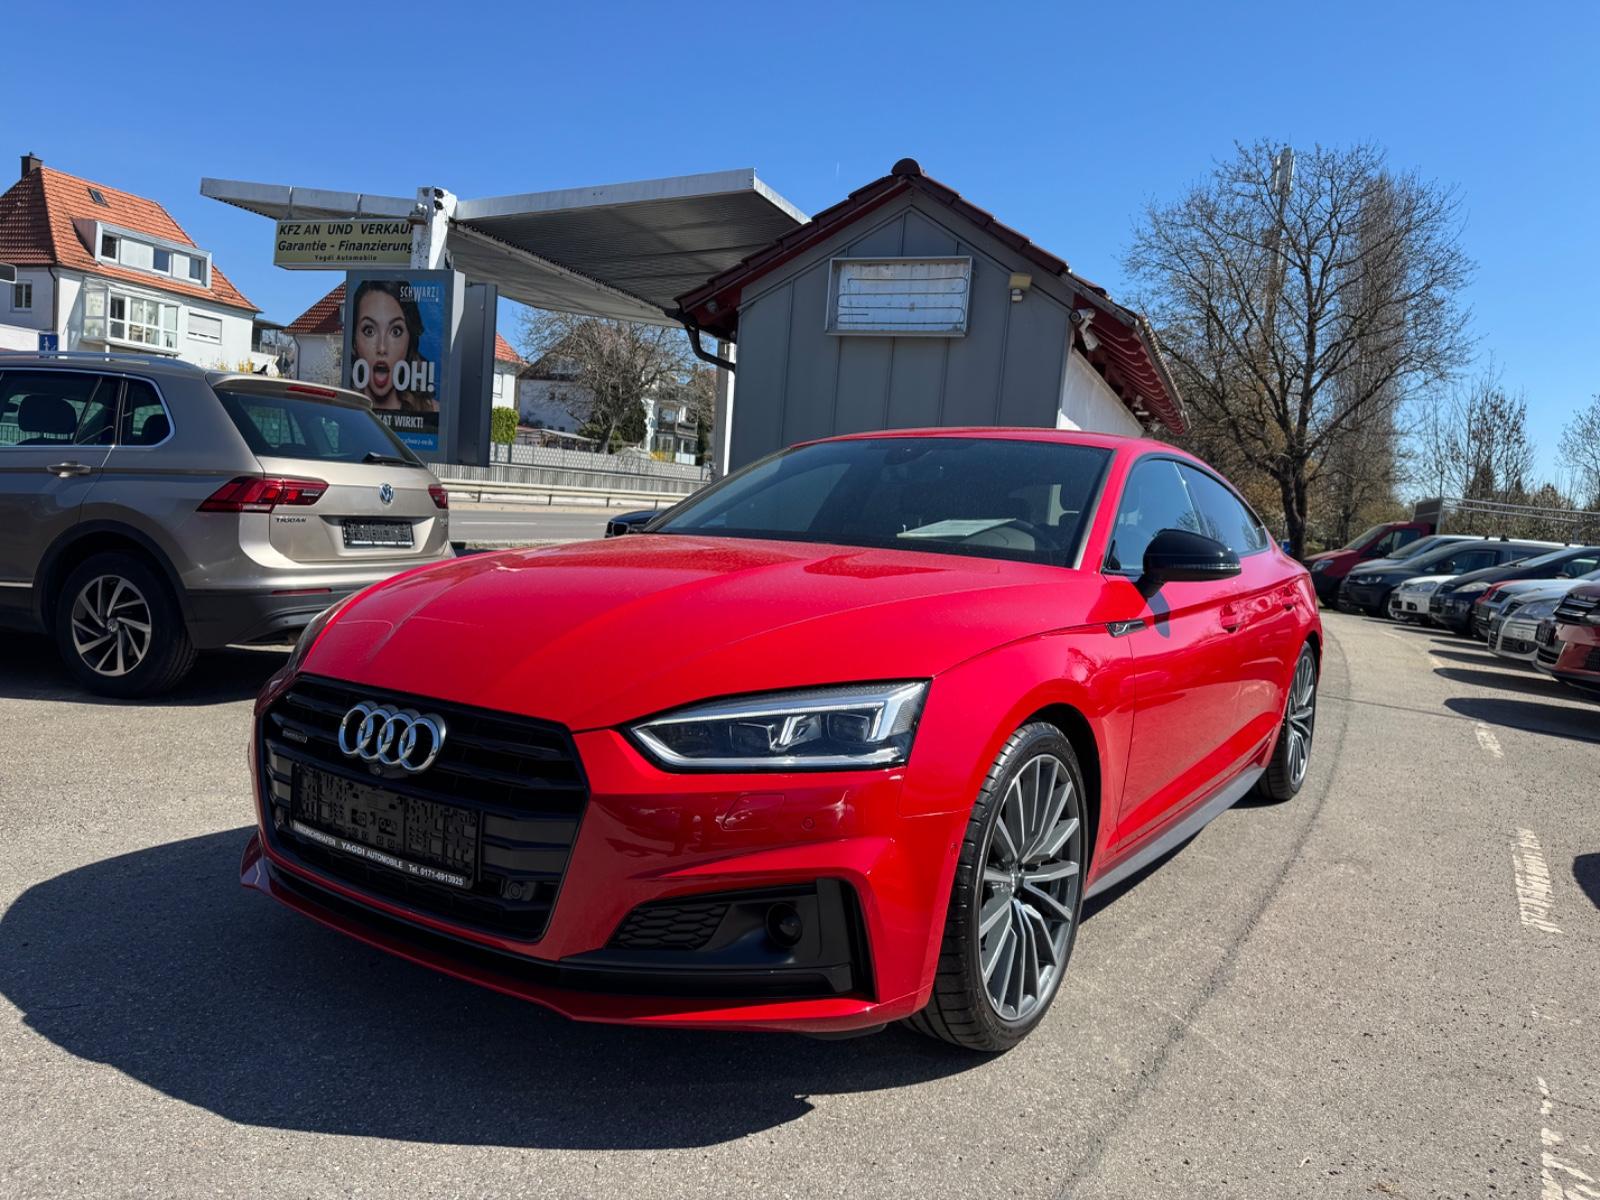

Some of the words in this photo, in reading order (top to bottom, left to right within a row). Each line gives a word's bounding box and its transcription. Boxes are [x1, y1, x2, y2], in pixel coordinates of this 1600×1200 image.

[279, 224, 301, 235] KFZ
[304, 224, 320, 235] AN
[328, 223, 353, 235] UND
[278, 240, 327, 252] Garantie
[394, 415, 424, 429] WIRKT!
[341, 841, 365, 857] YAGDI
[367, 850, 403, 869] AUTOMOBILE
